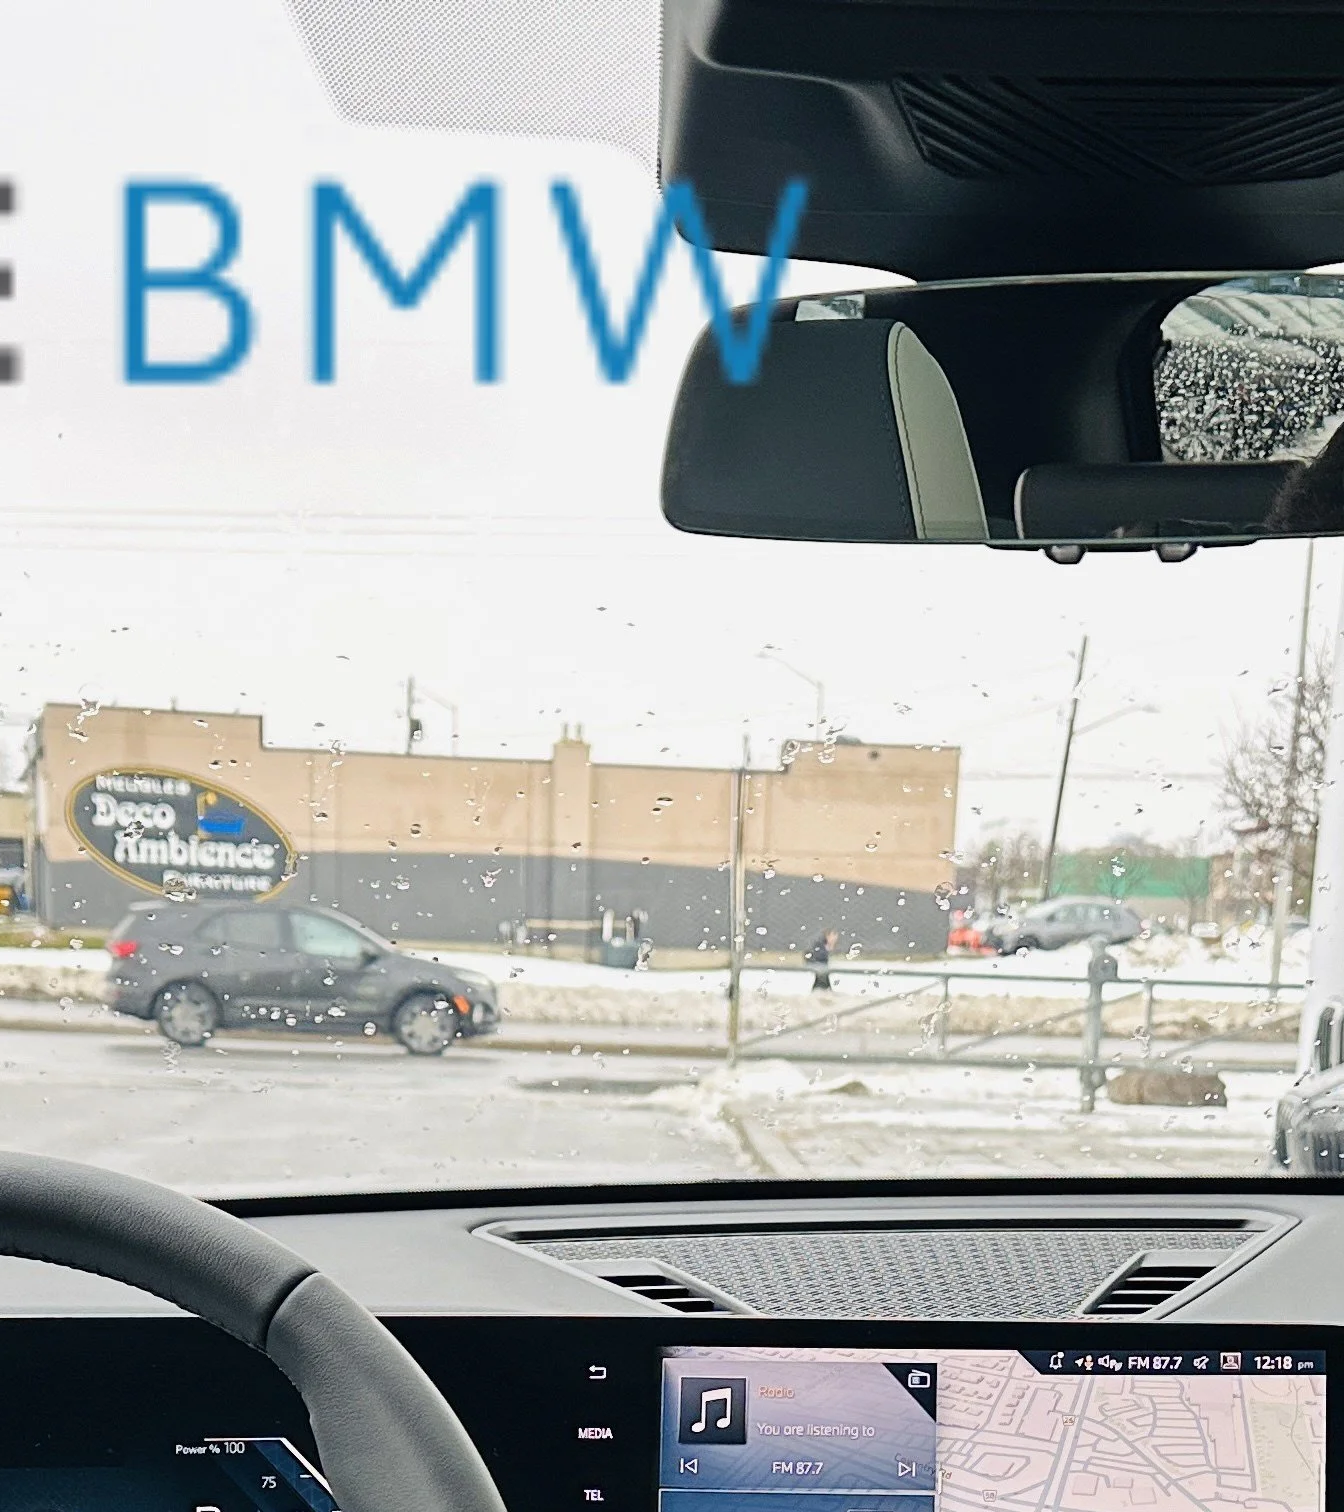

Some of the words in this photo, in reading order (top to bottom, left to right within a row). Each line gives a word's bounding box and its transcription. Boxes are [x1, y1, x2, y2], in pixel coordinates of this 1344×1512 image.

[1127, 1356, 1150, 1370] FM
[1152, 1356, 1183, 1370] 87.7
[1254, 1356, 1293, 1370] 12:18
[1297, 1360, 1314, 1371] pm
[759, 1385, 795, 1399] Radio
[578, 1427, 613, 1439] MEDIA
[757, 1423, 780, 1436] You
[783, 1426, 803, 1436] are
[806, 1423, 859, 1439] listening
[861, 1425, 875, 1437] to
[175, 1444, 207, 1455] Power
[223, 1442, 245, 1454] 100
[772, 1462, 793, 1475] FM
[795, 1462, 824, 1475] 87.7
[261, 1476, 277, 1489] 75
[584, 1489, 604, 1501] TEL
